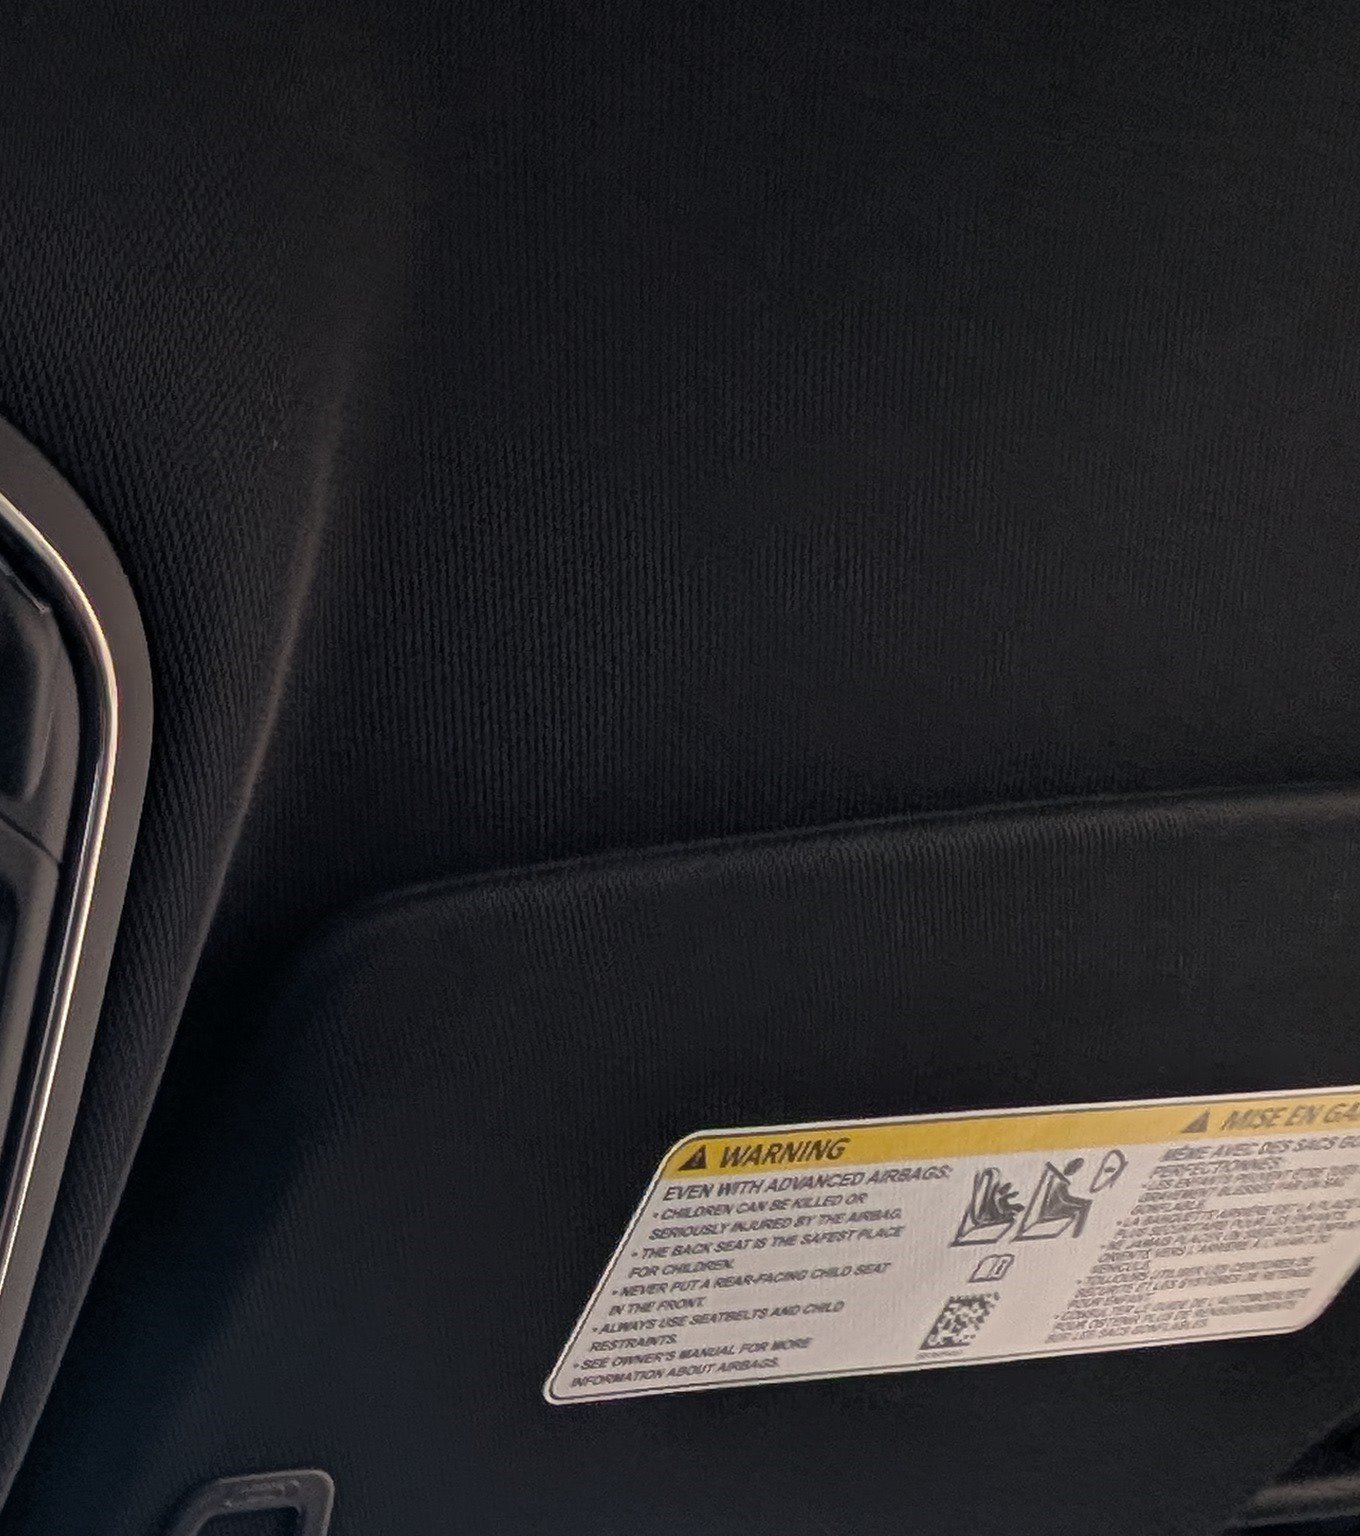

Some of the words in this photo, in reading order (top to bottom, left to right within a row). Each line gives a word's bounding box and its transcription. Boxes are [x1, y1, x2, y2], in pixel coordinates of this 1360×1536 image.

[1221, 1107, 1286, 1131] MISE
[1285, 1104, 1323, 1126] EN
[720, 1138, 850, 1167] WARNING
[662, 1184, 713, 1200] EVEN
[715, 1180, 763, 1196] WITH
[765, 1172, 865, 1191] ADVANCED
[866, 1164, 954, 1183] AIRBAGS:
[661, 1204, 733, 1219] CHILDREN
[735, 1201, 767, 1213] CAN
[769, 1199, 791, 1210] BE
[791, 1194, 843, 1208] KILLED
[844, 1192, 867, 1204] OR
[649, 1222, 728, 1238] SERIOUSLY
[731, 1217, 792, 1232] INJURED
[793, 1215, 814, 1227] BY
[814, 1213, 844, 1225] THE
[640, 1246, 669, 1258] THE
[671, 1243, 712, 1255] BACK
[713, 1239, 750, 1251] SEAT
[751, 1238, 768, 1248] IS
[769, 1235, 798, 1247] THE
[799, 1231, 853, 1244] SAFEST
[856, 1226, 903, 1239] PLACE
[620, 1283, 668, 1295] NEVER
[670, 1280, 699, 1291] PUT
[700, 1279, 711, 1288] A
[809, 1266, 851, 1278] CHILD
[854, 1263, 889, 1274] SEAT
[629, 1265, 658, 1277] FOR
[600, 1320, 655, 1332] ALWAYS
[658, 1316, 687, 1327] USE
[688, 1309, 768, 1324] SEATBELTS
[770, 1305, 800, 1316] AND
[802, 1301, 844, 1313] CHILD
[609, 1304, 624, 1314] IN
[624, 1302, 655, 1313] THE
[580, 1357, 609, 1368] SEE
[611, 1351, 676, 1365] OWNER'S
[677, 1345, 736, 1359] MANUAL
[739, 1342, 767, 1353] FOR
[571, 1370, 663, 1386] INFORMATION
[666, 1364, 713, 1377] ABOUT
